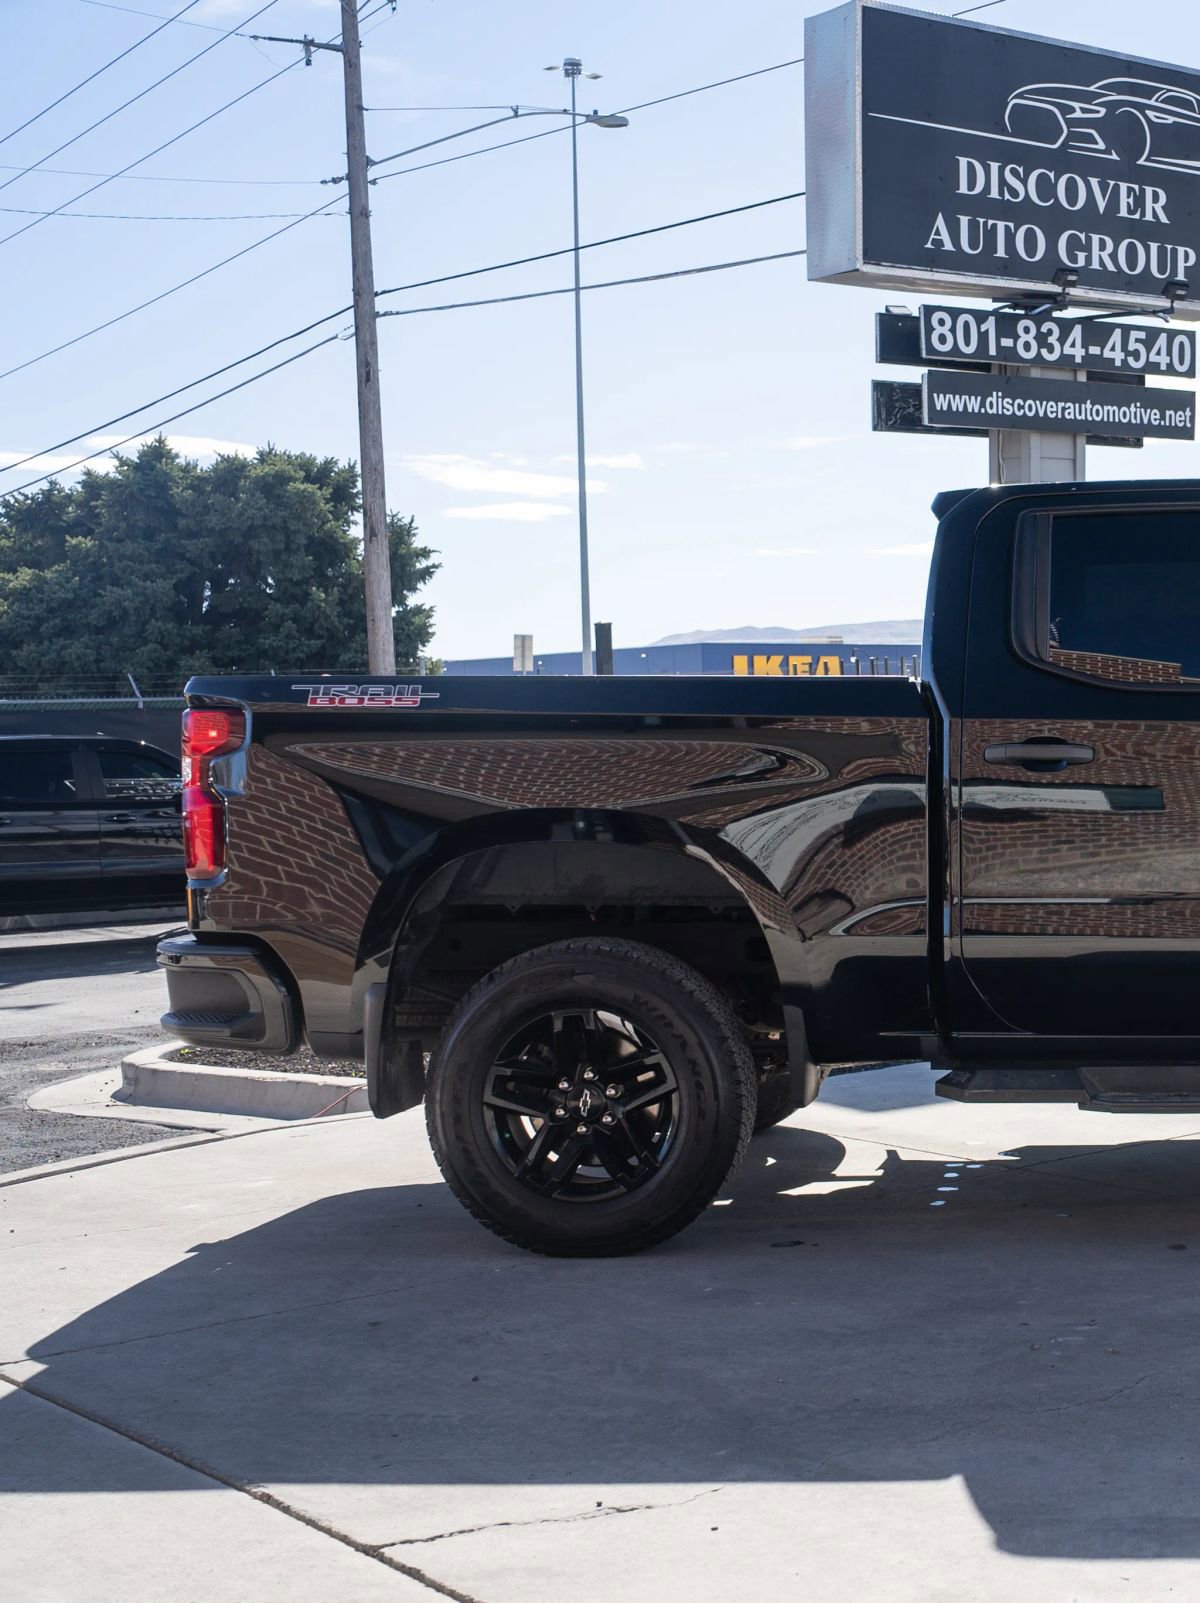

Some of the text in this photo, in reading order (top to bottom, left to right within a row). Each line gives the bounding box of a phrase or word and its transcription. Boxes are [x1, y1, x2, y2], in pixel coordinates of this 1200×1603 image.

[955, 155, 1170, 224] DISCOVER
[924, 212, 1197, 281] AUTO GROUP
[930, 311, 1191, 373] 801-834-4540
[933, 391, 1192, 428] www.discoverautomotive.net
[733, 655, 841, 676] IKEA
[291, 685, 440, 697] TRAIL
[307, 696, 421, 707] BOSS
